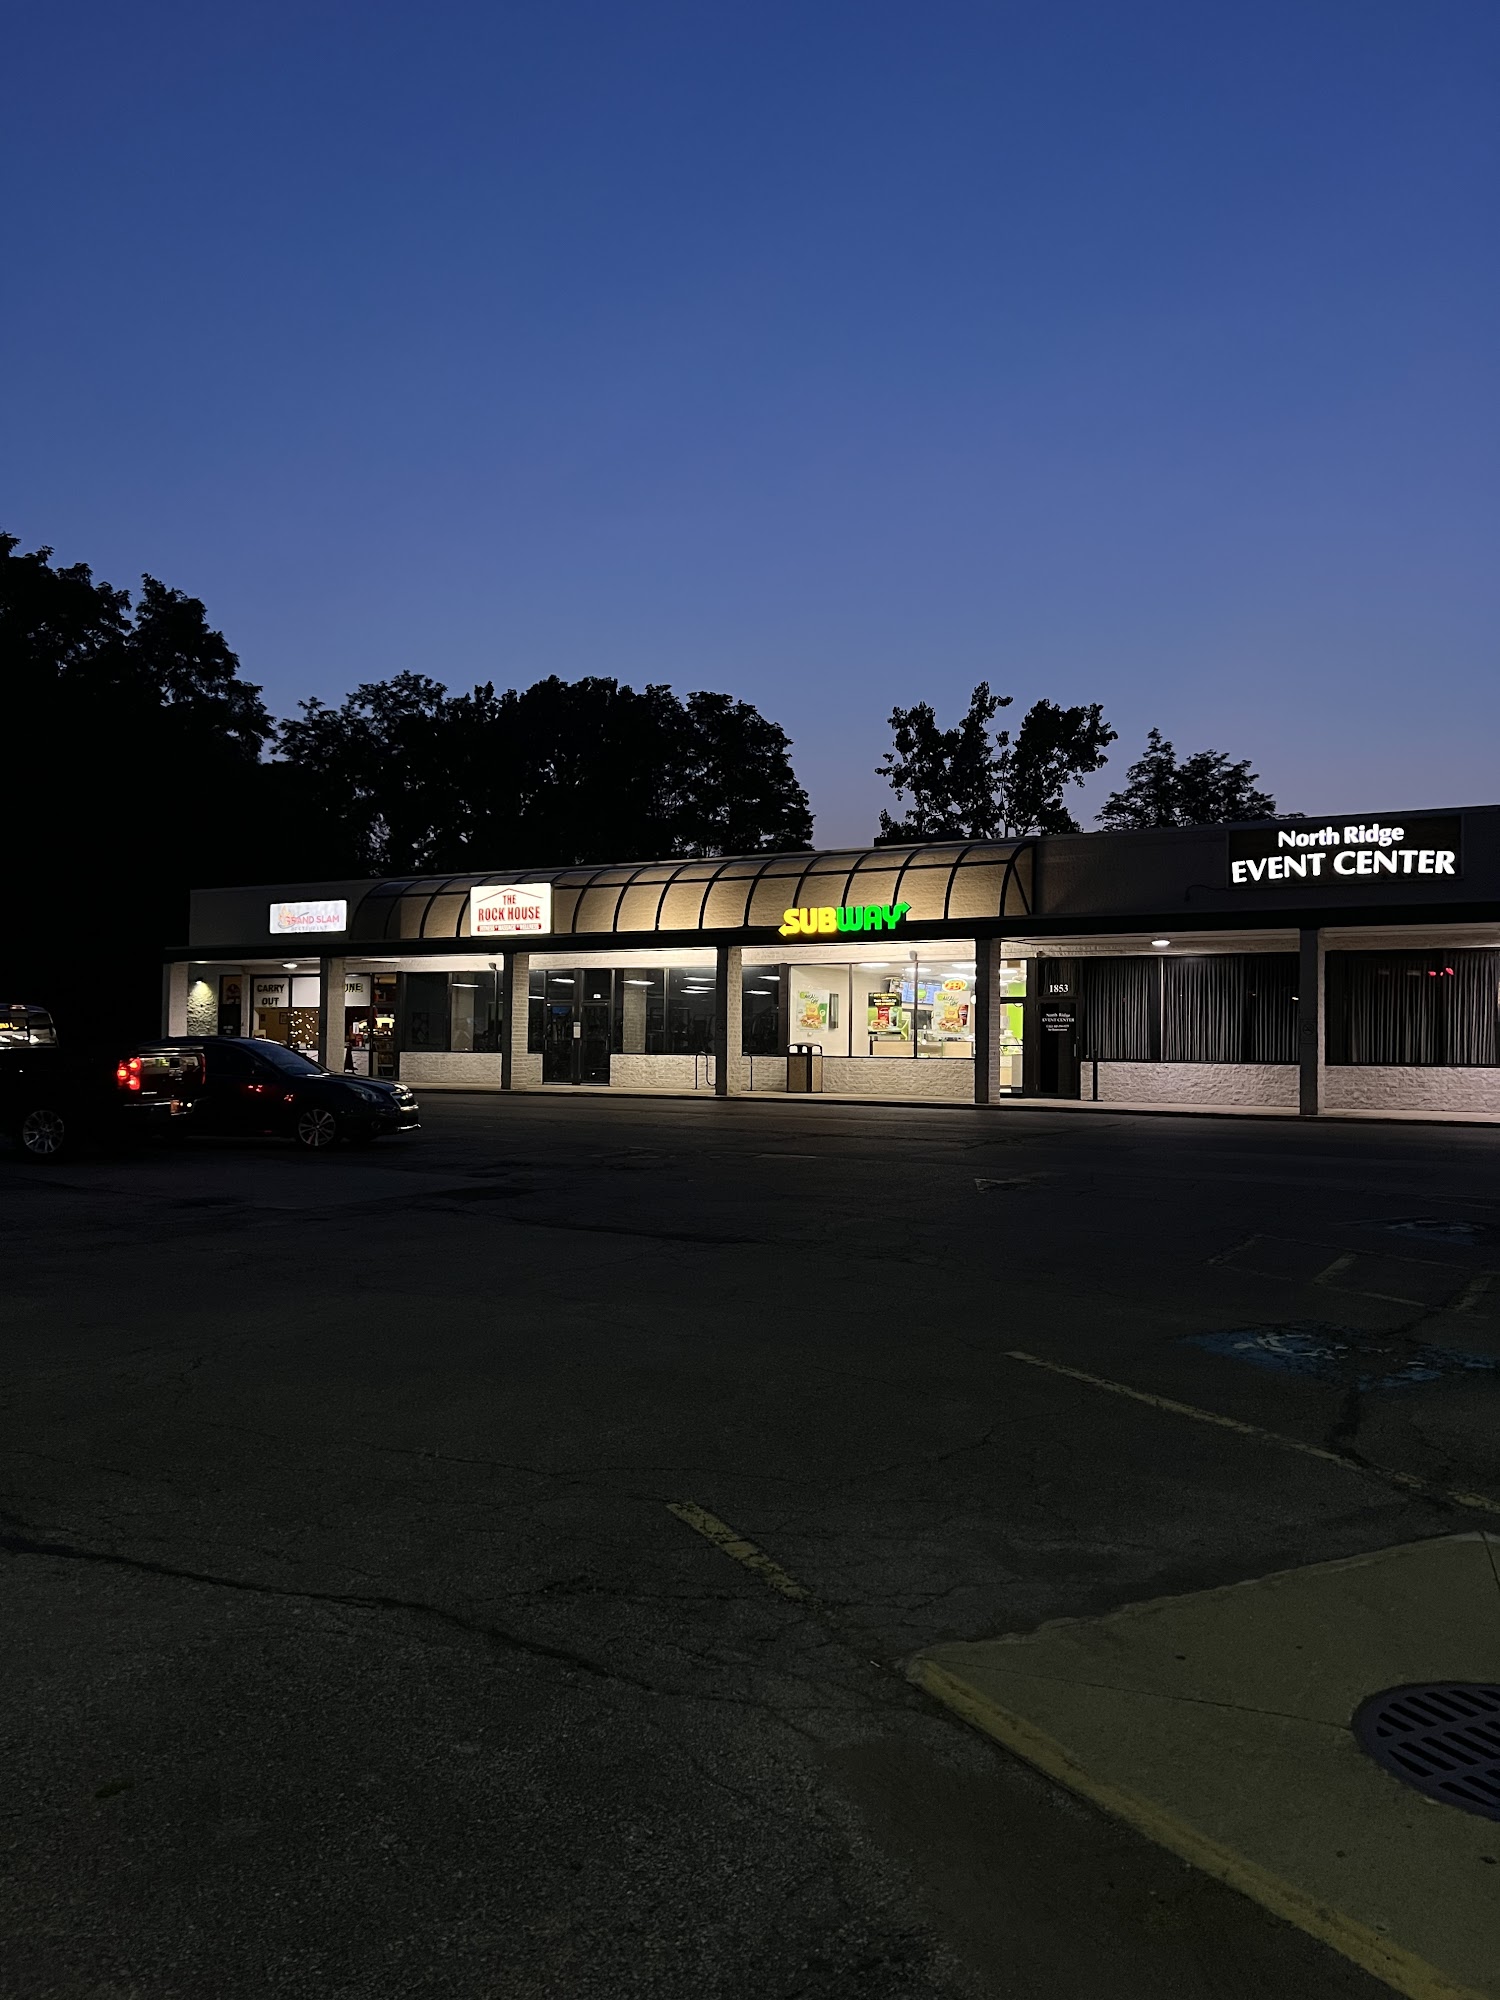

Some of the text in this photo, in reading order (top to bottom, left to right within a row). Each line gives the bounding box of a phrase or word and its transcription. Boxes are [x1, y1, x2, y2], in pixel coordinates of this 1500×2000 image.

[1277, 823, 1405, 848] North Ridge
[1231, 849, 1456, 884] EVENT CENTER
[502, 894, 516, 906] THE
[316, 914, 340, 925] SLAM
[478, 905, 541, 922] ROCK HOUSE
[776, 901, 913, 937] SUBWAY
[256, 983, 285, 993] CARRY
[1049, 984, 1069, 993] 1853
[261, 997, 280, 1006] OUT
